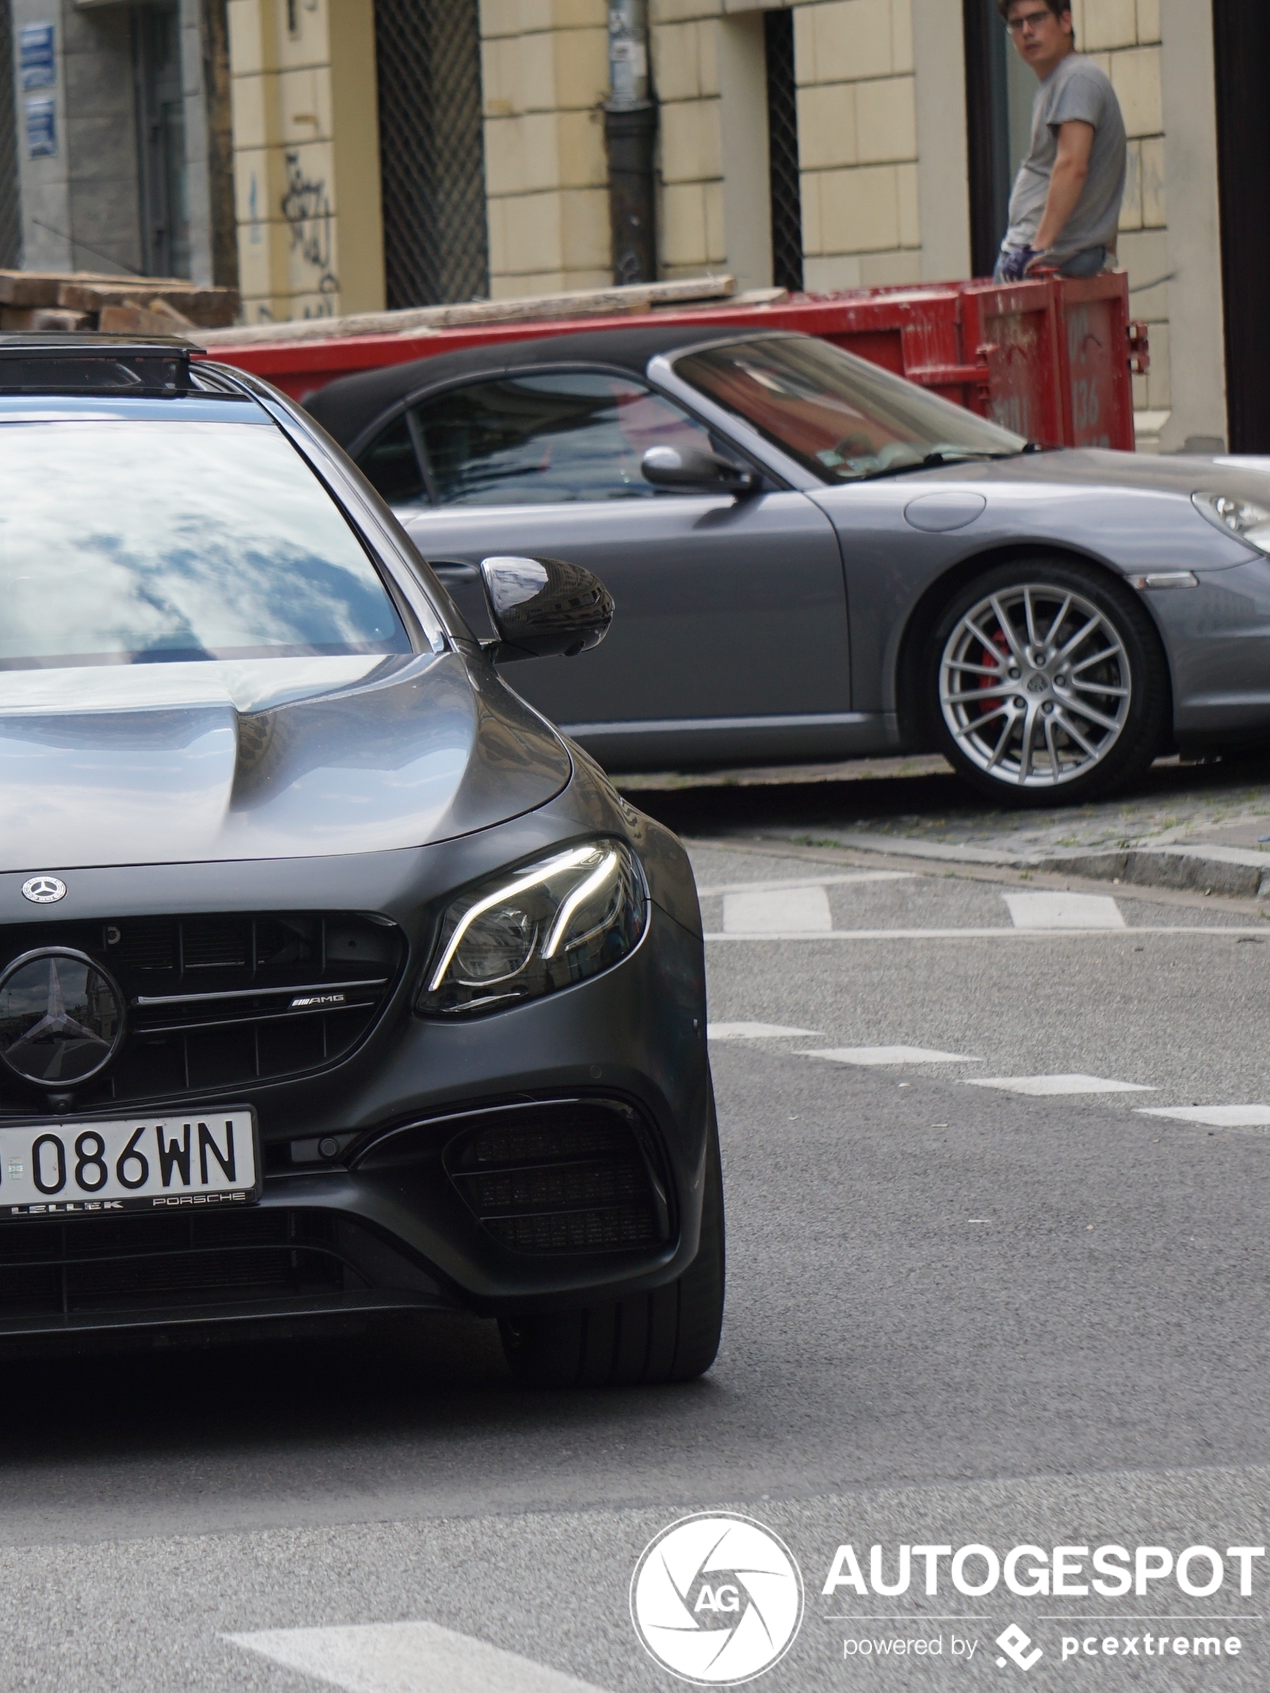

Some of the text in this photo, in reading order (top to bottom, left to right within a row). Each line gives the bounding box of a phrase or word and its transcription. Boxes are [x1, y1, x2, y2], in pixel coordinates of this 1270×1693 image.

[309, 994, 344, 1005] AMG
[32, 1121, 236, 1195] 086WN
[11, 1200, 124, 1215] LELLEK
[152, 1192, 246, 1206] PORSCHE
